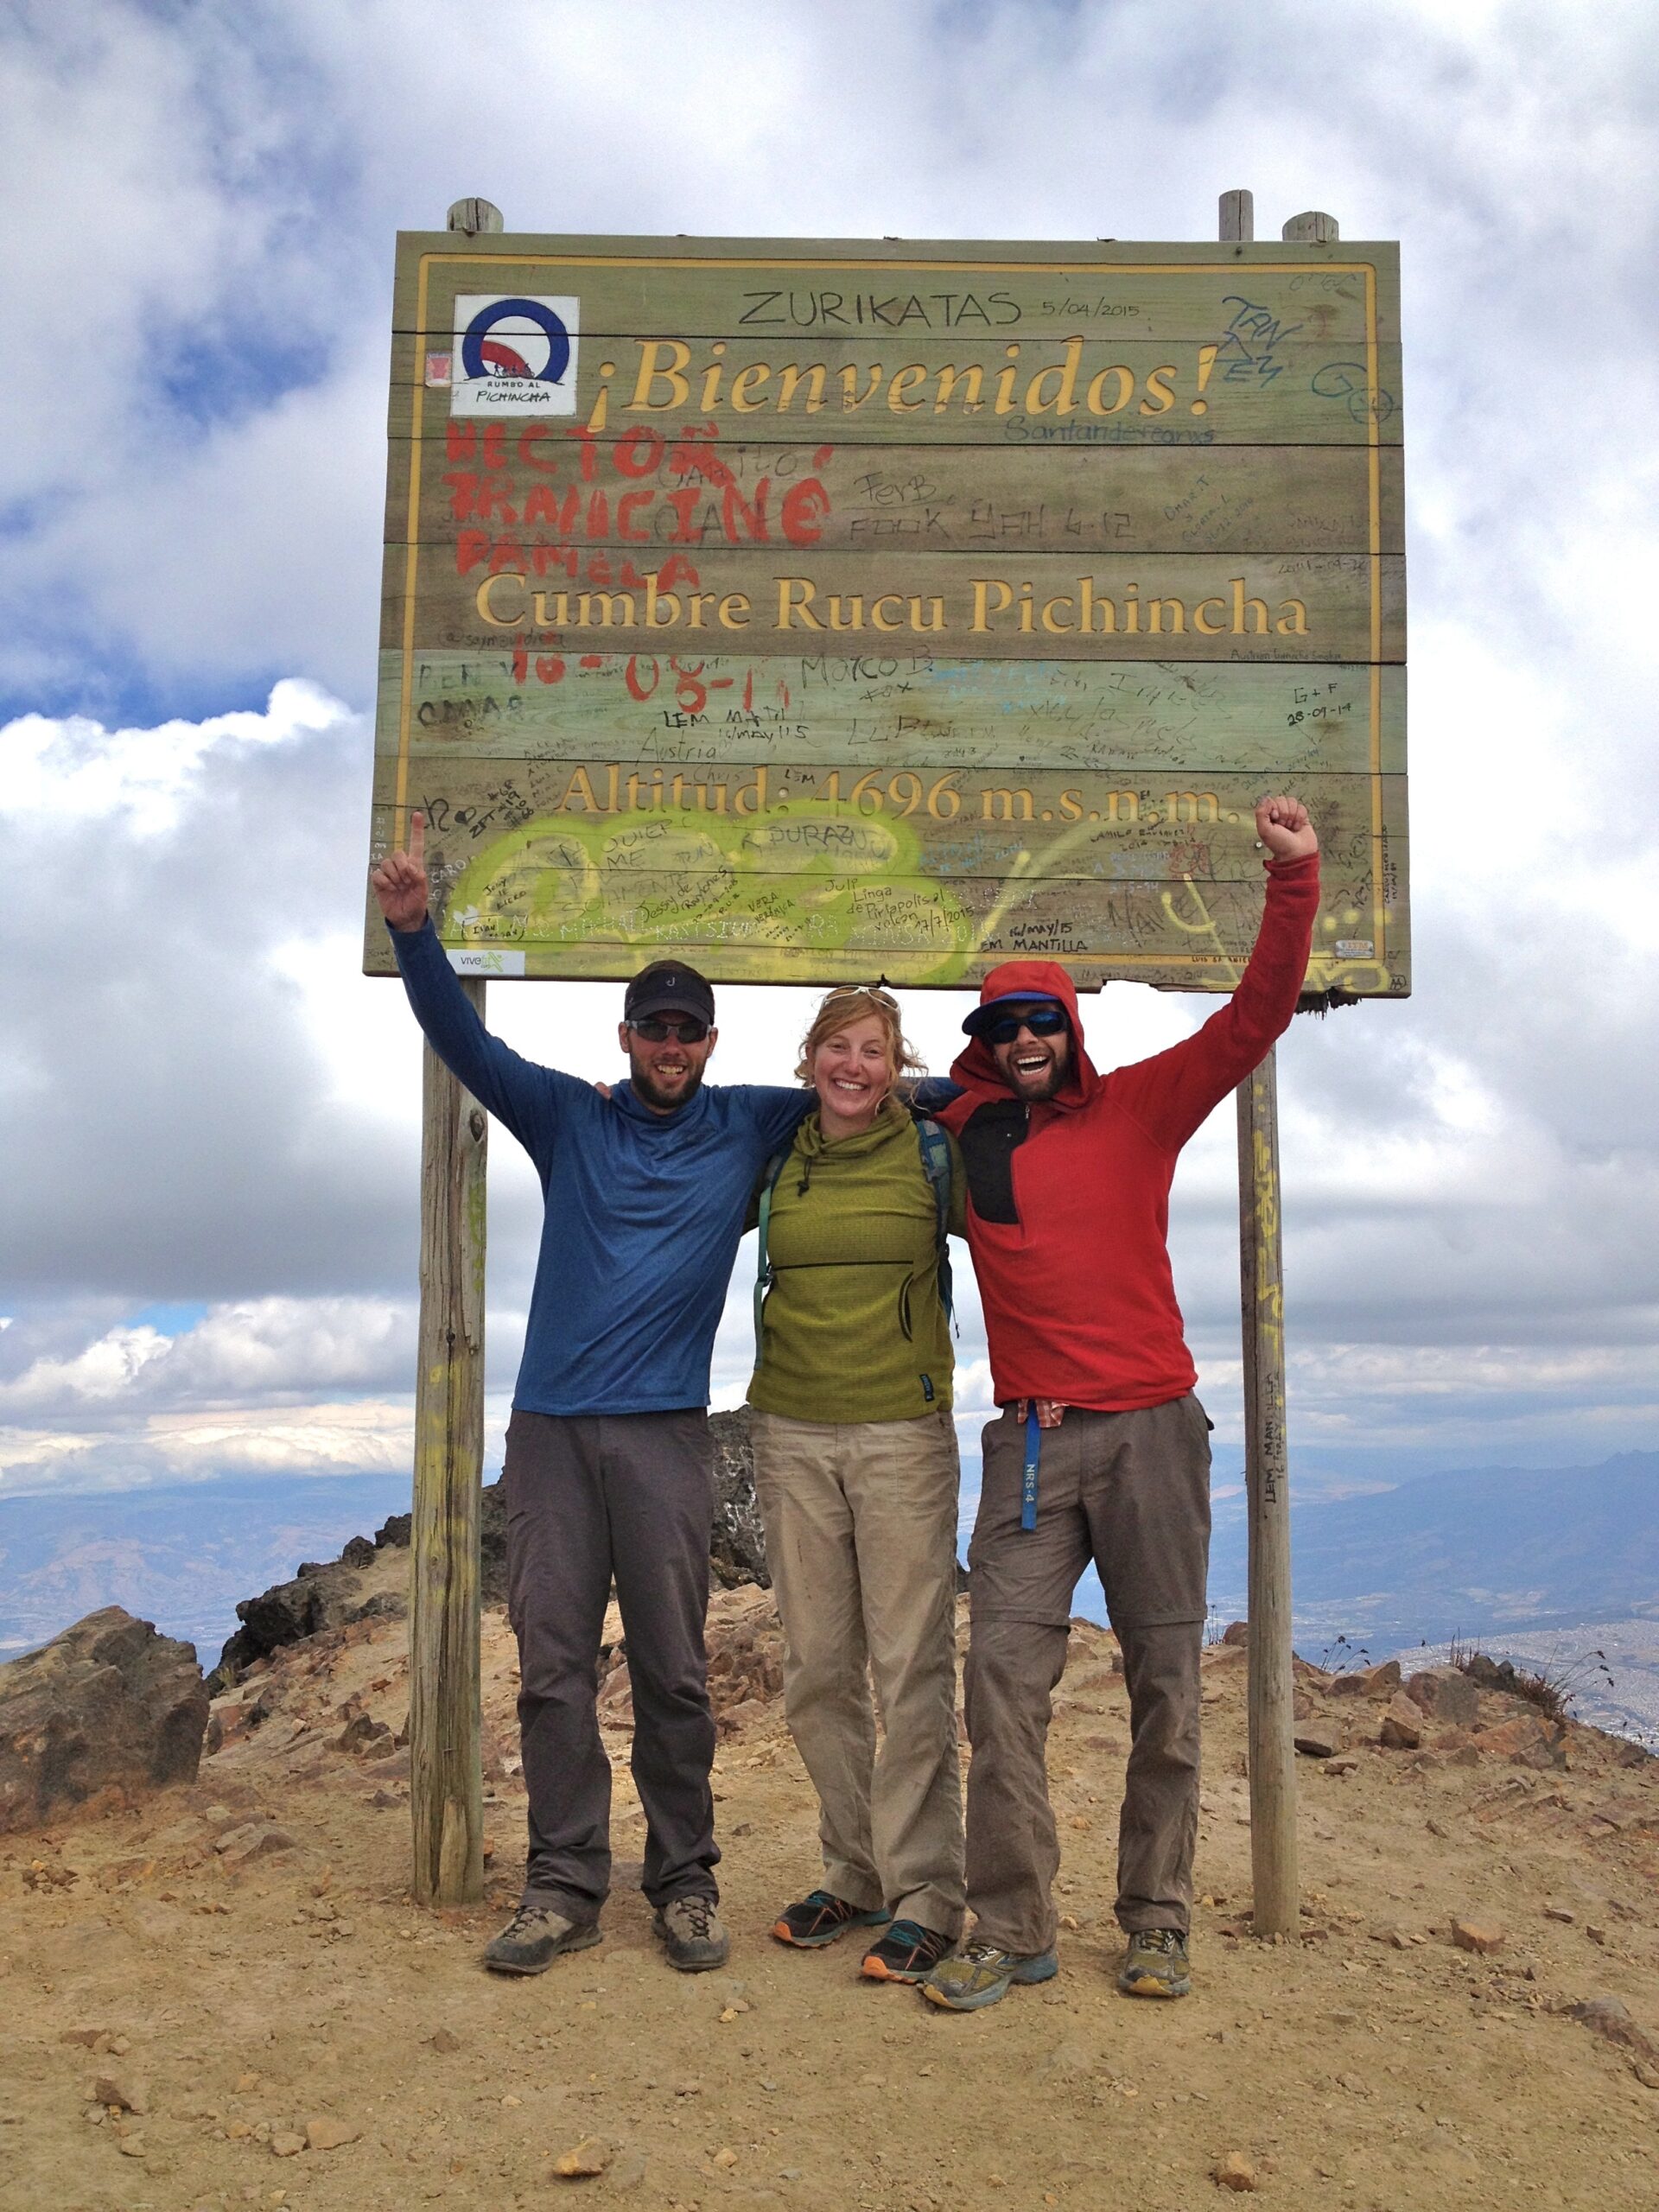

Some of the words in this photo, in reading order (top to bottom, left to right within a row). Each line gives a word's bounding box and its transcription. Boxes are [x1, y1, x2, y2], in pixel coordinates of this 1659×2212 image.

[738, 291, 1022, 328] ZURIKATAS
[1042, 296, 1141, 317] 5/04/2015
[476, 390, 551, 403] PICHINCHA
[586, 334, 1218, 433] ¡Bienvenidos!
[475, 570, 751, 629] Cumbre
[772, 575, 949, 632] Rucu
[967, 575, 1312, 636] Pichincha
[811, 767, 963, 820] 4696
[980, 785, 1242, 823] m.s.n.m.
[1013, 938, 1089, 952] MANTILLA
